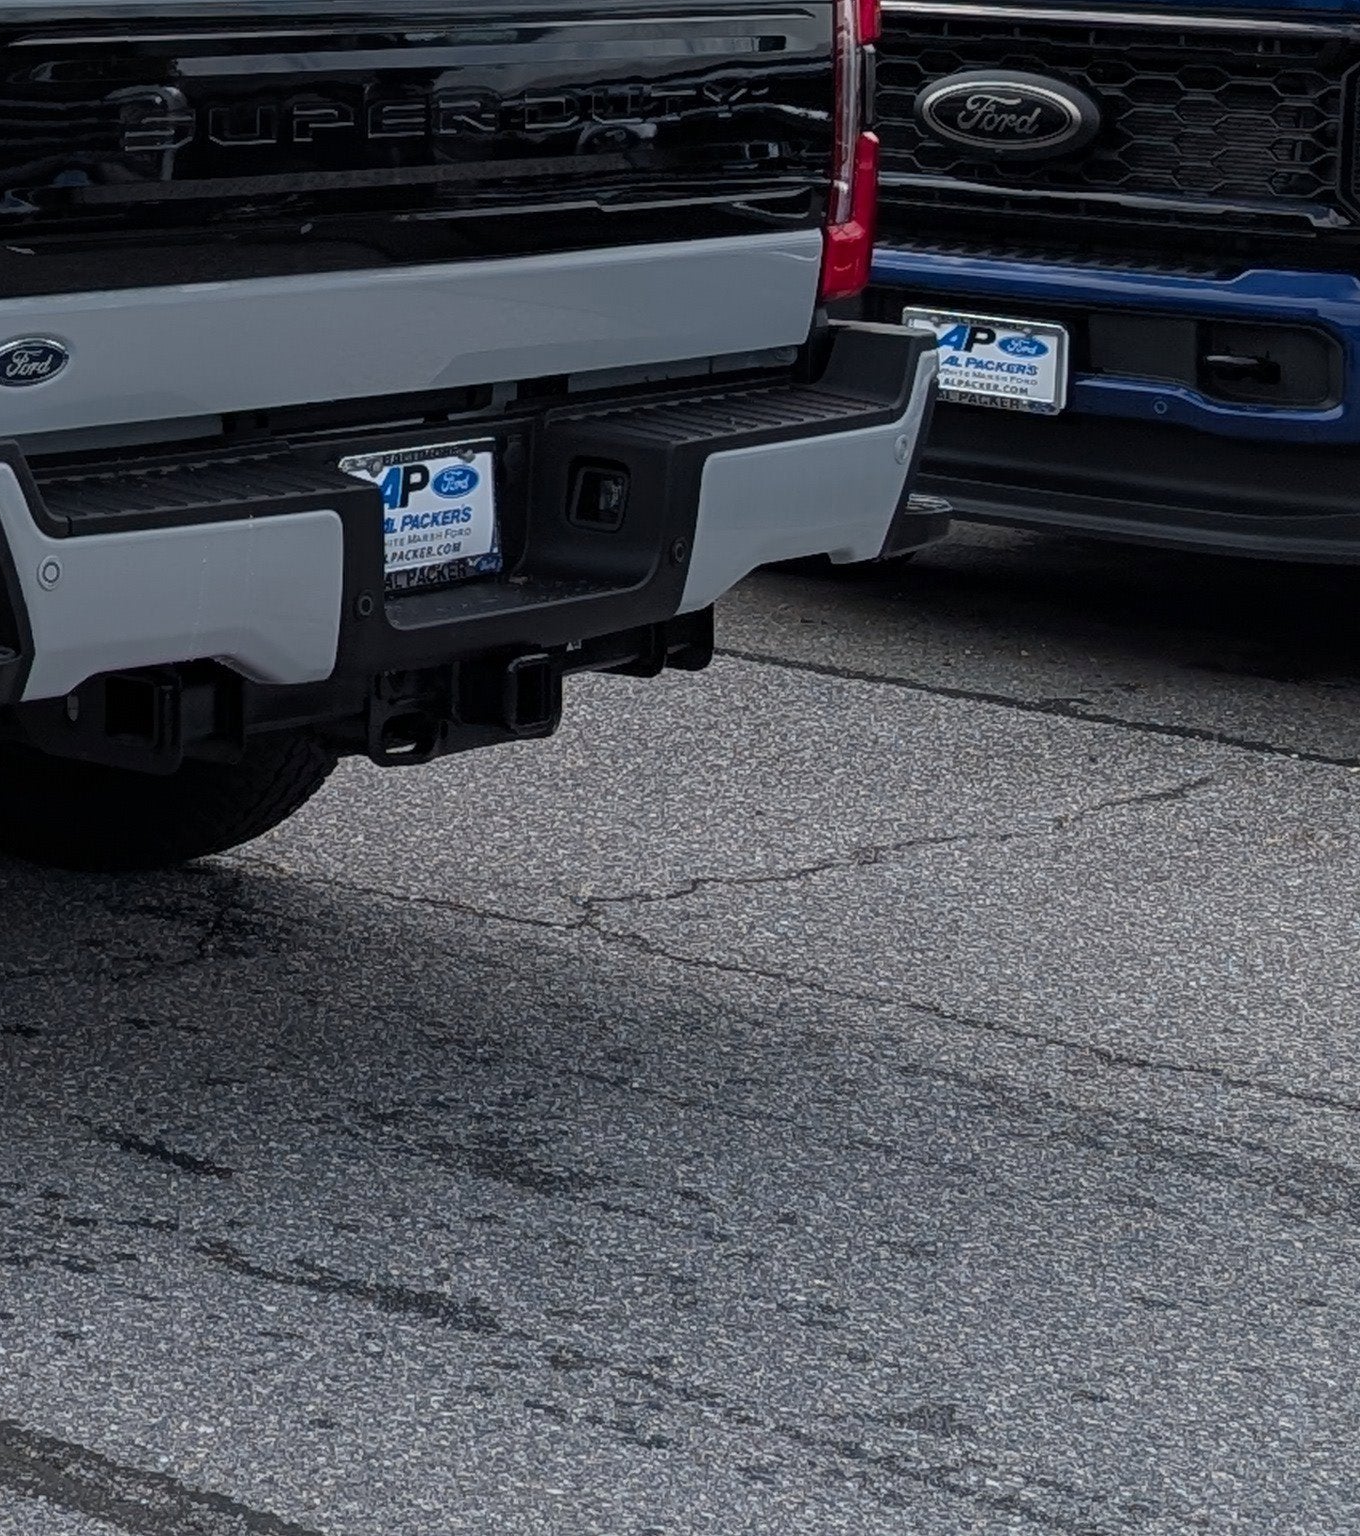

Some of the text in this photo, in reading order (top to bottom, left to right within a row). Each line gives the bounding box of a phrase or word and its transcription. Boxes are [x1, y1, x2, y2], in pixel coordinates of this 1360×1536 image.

[118, 83, 770, 152] SUPER DUTY
[956, 94, 1043, 135] Ford
[938, 324, 996, 353] AP
[5, 349, 54, 378] Ford
[941, 355, 962, 368] AL
[381, 464, 430, 510] AP
[444, 527, 473, 539] FORD
